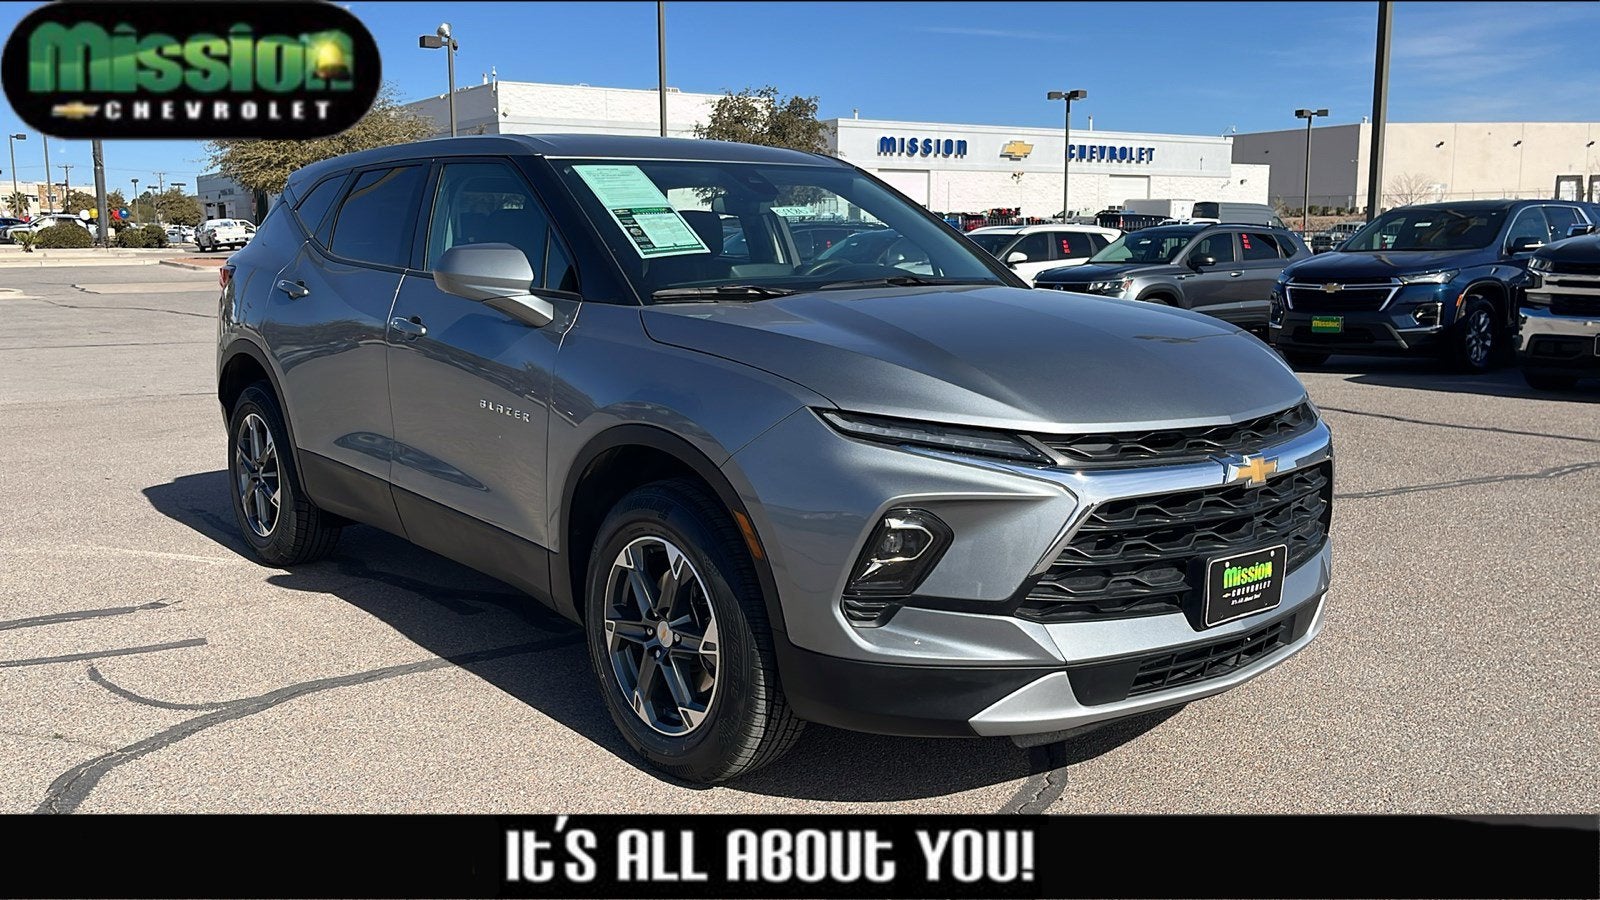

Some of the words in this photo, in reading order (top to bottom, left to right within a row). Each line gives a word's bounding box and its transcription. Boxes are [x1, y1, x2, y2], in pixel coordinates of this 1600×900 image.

[1067, 144, 1155, 162] CHEVROLET
[479, 399, 530, 423] BLAZER
[1223, 561, 1273, 590] Mission
[1231, 580, 1272, 598] CHEVROLET
